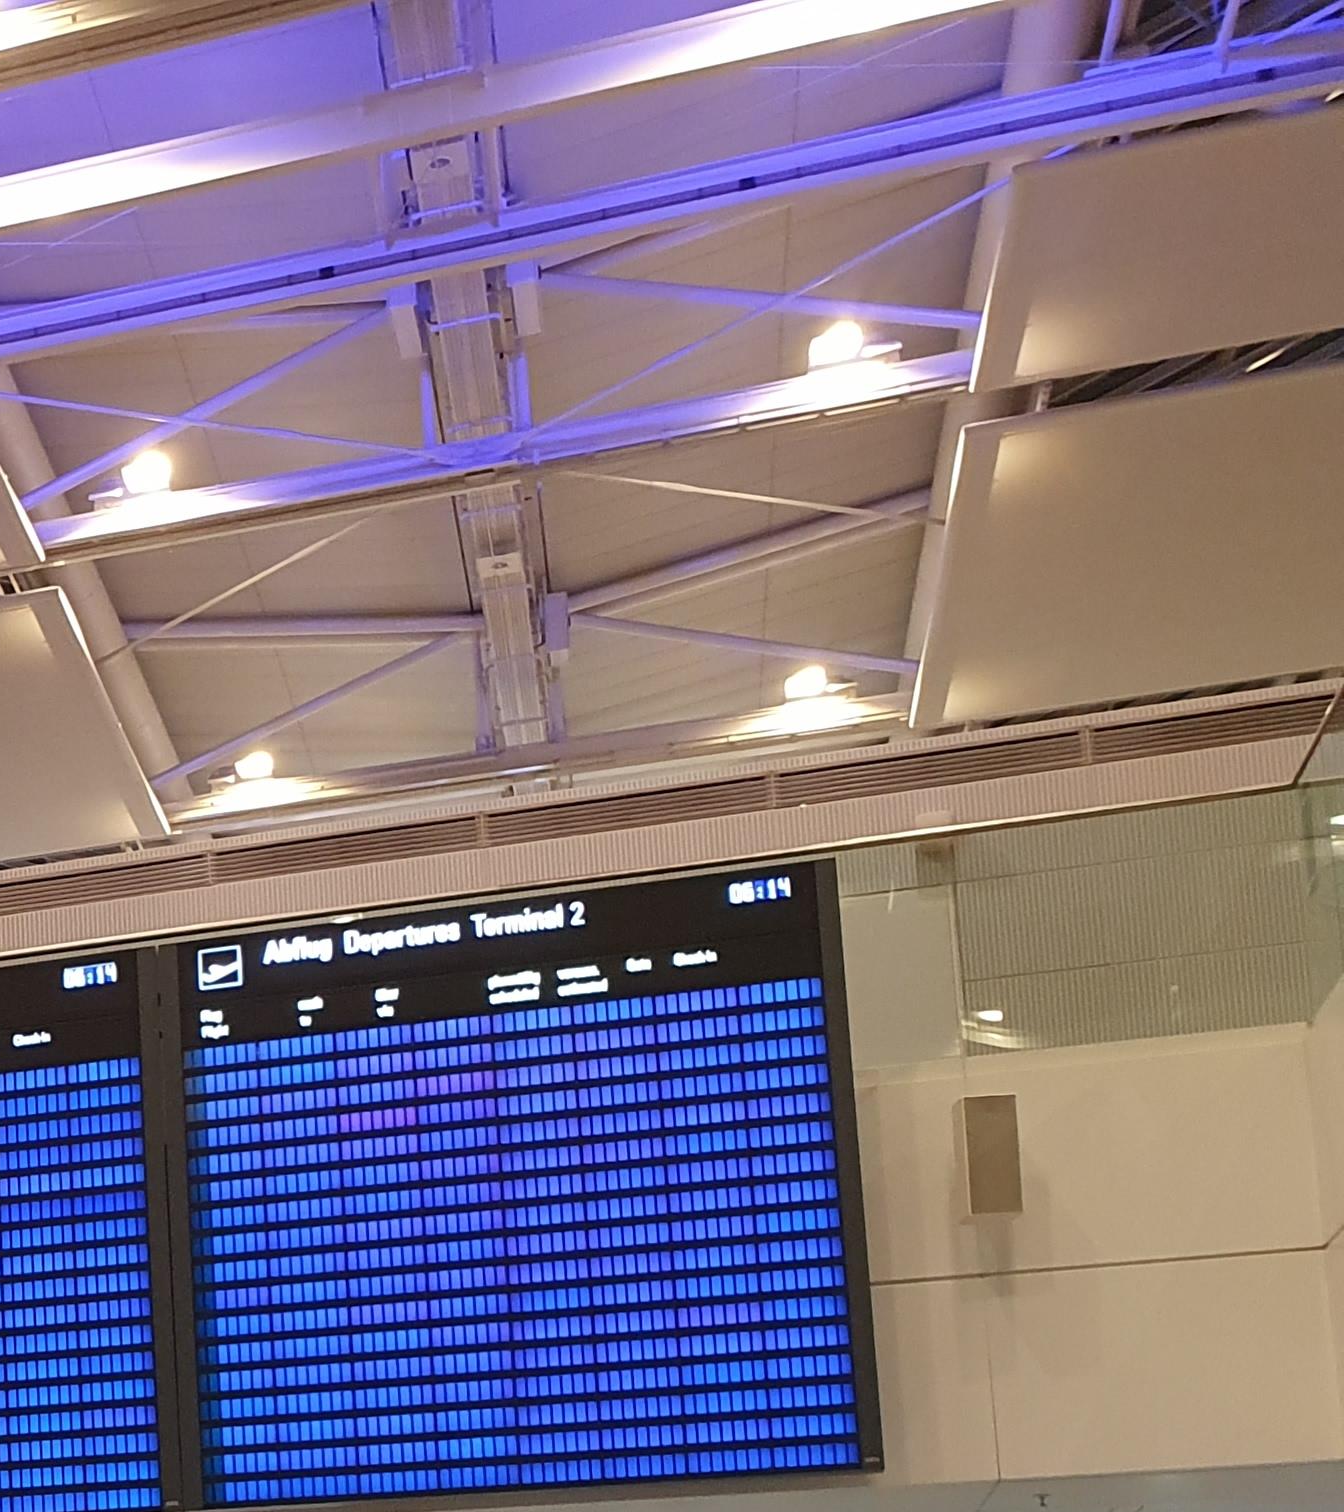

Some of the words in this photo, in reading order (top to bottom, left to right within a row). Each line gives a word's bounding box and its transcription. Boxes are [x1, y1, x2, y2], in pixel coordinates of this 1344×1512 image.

[264, 937, 332, 964] Abflug
[341, 918, 460, 954] Departures
[471, 904, 563, 936] Terminal
[570, 902, 585, 925] 2
[730, 878, 790, 903] 06:14
